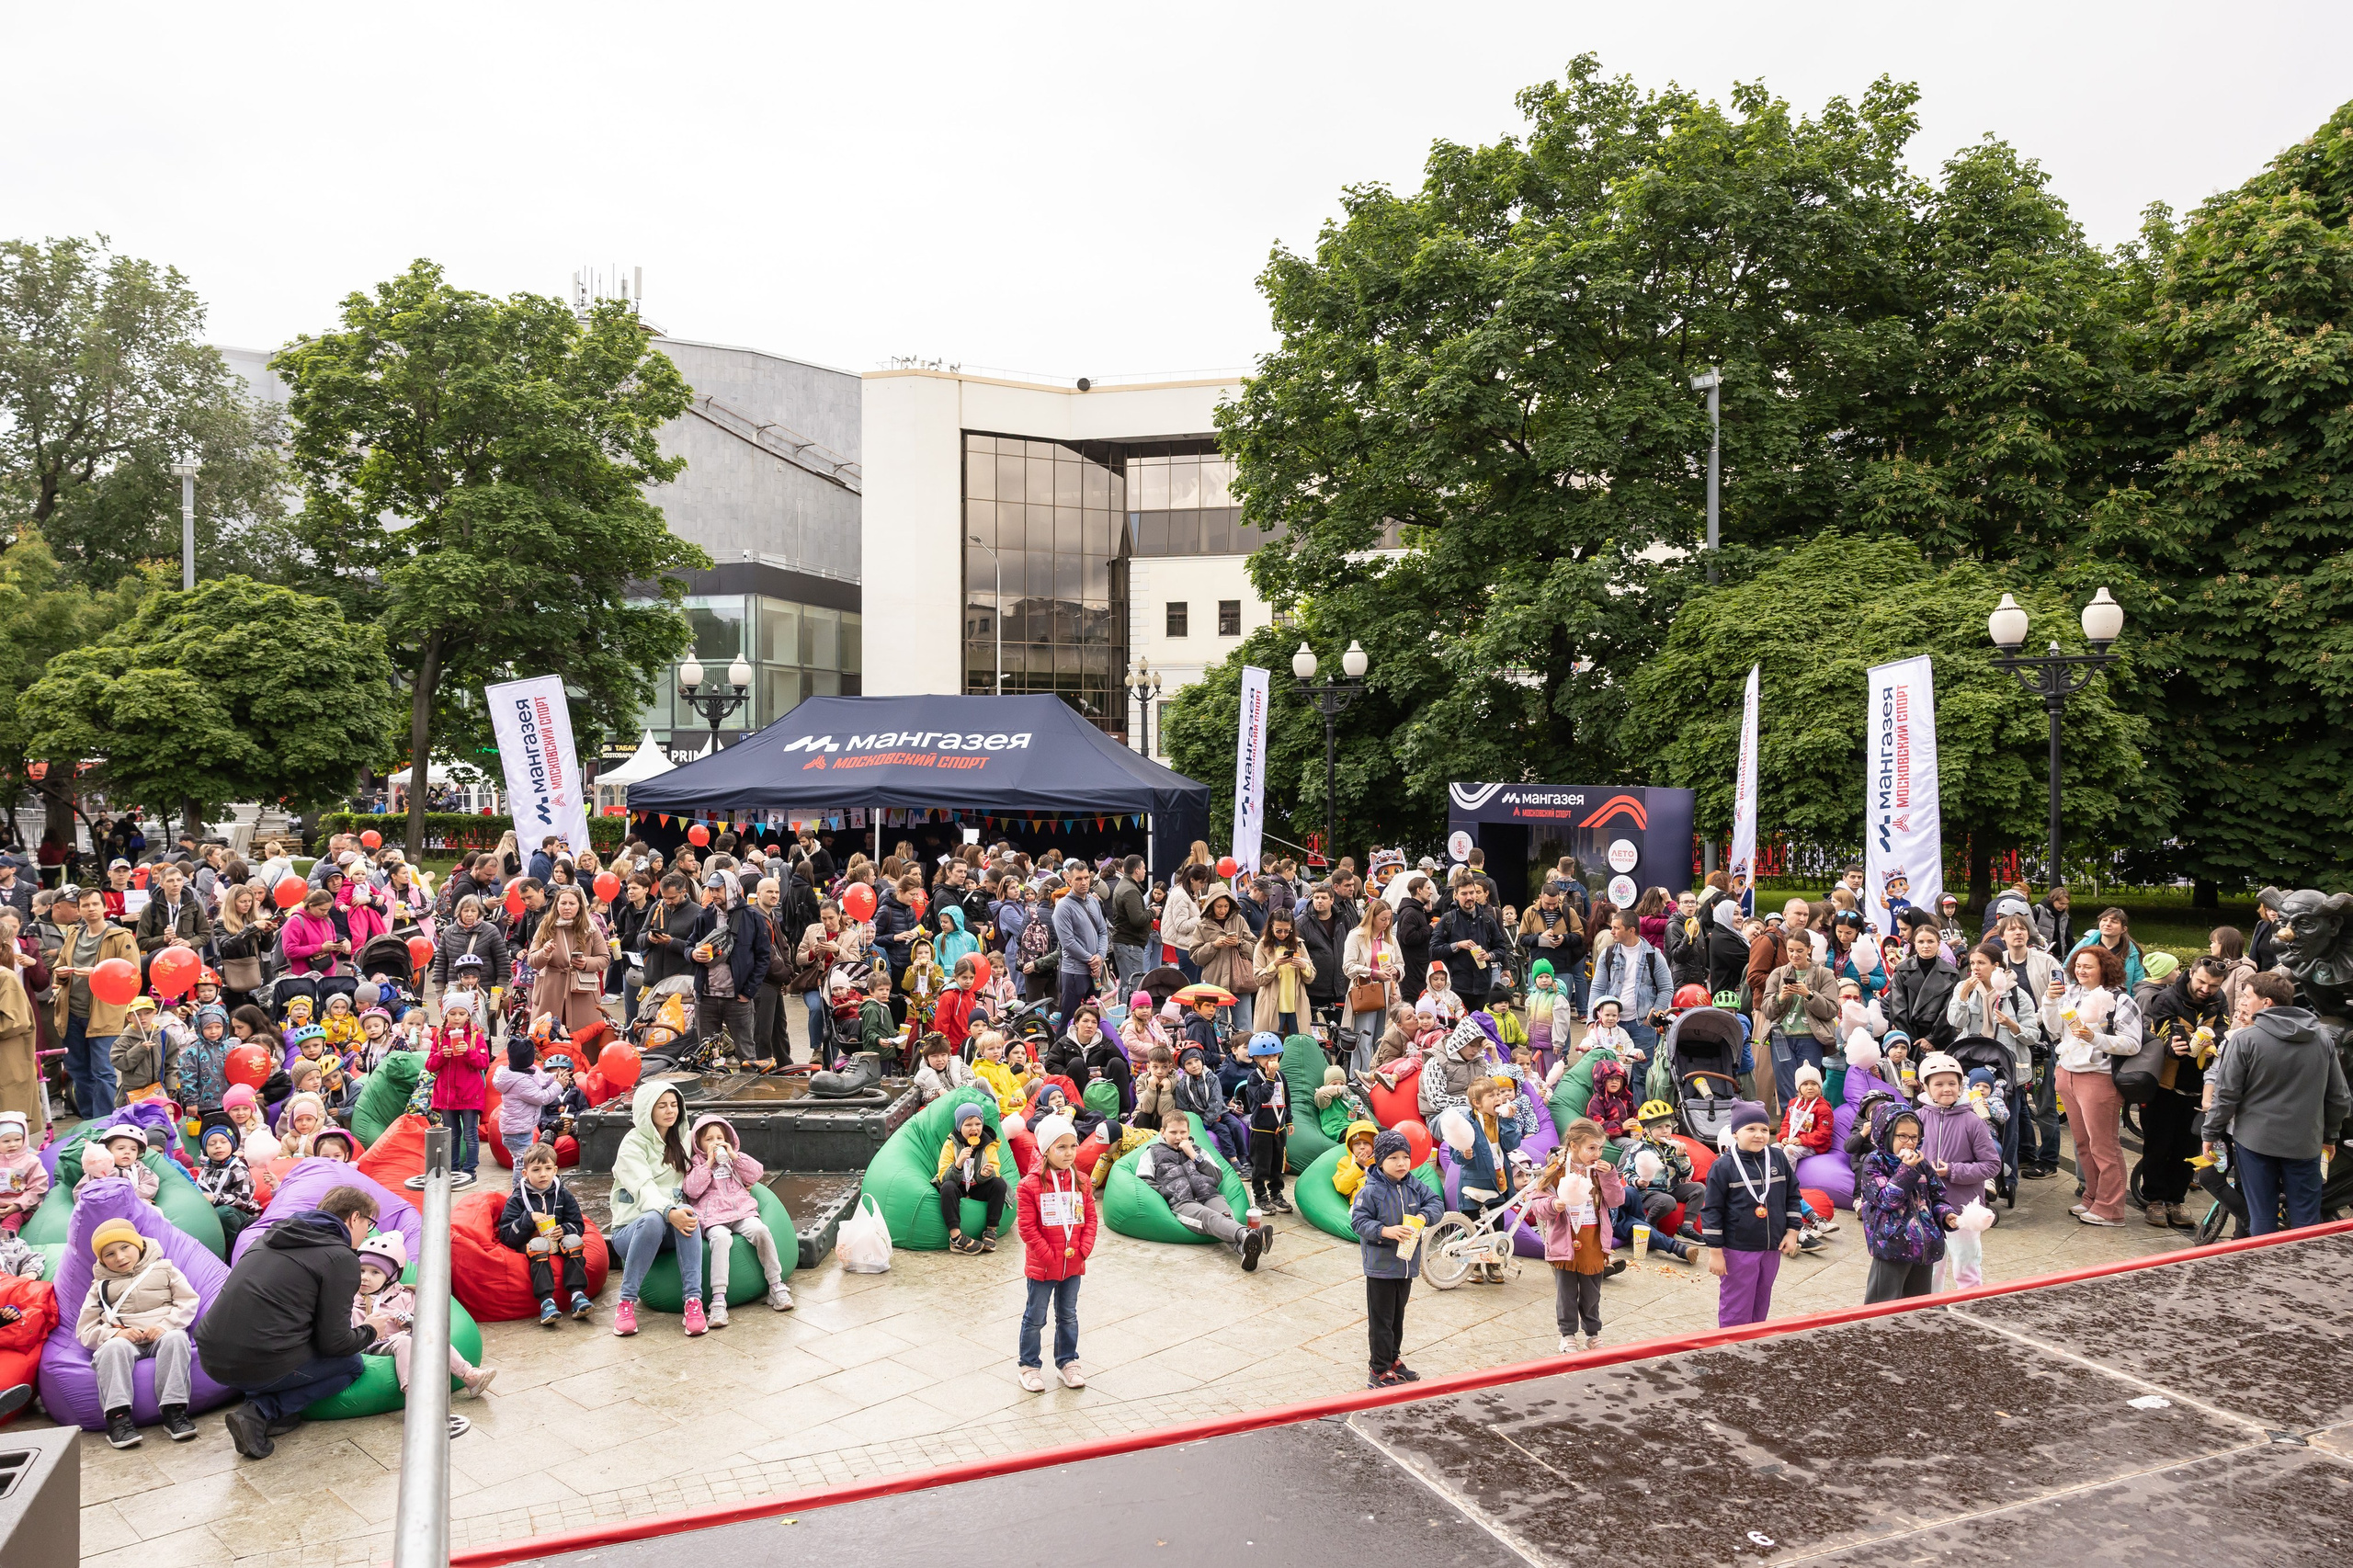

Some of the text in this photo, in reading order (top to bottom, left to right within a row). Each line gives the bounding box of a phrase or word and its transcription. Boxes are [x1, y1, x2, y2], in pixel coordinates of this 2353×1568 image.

[516, 699, 547, 793] мангазея
[534, 696, 563, 790] МОСКОВСКИЙ СПОРТ
[845, 731, 1032, 752] мангазея
[1880, 687, 1893, 809] мангазея
[1894, 684, 1909, 808] МОСКОВСКИЙ СПОРТ
[832, 752, 990, 769] МОСКОВСКИЙ СПОРТ
[1522, 793, 1585, 805] мангазея
[1522, 808, 1572, 818] МОСКОВСКИЙ СПОРТ
[1610, 849, 1634, 858] ЛЕТО
